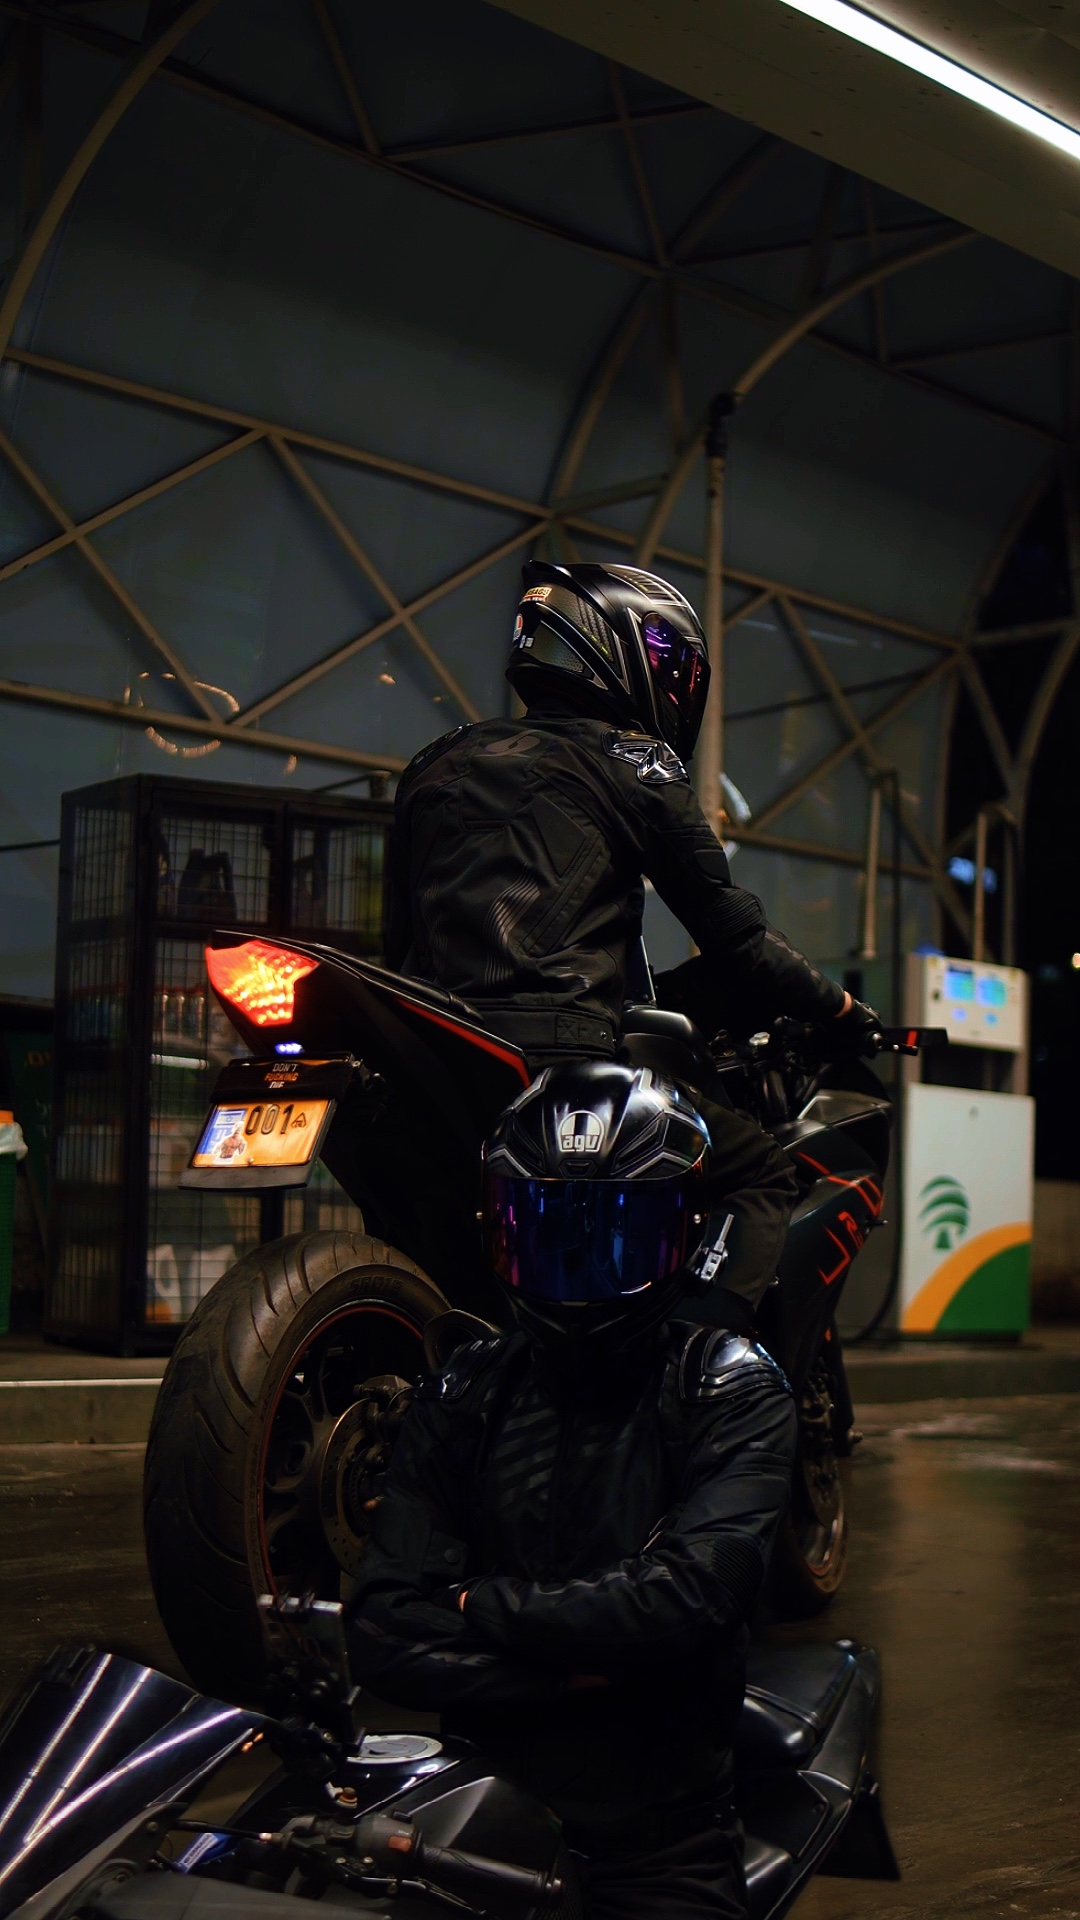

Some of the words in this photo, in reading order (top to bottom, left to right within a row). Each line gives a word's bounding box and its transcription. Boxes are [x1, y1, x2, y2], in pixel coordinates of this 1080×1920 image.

[272, 1063, 299, 1072] DON'T
[246, 1104, 294, 1135] 001
[563, 1135, 598, 1152] agv
